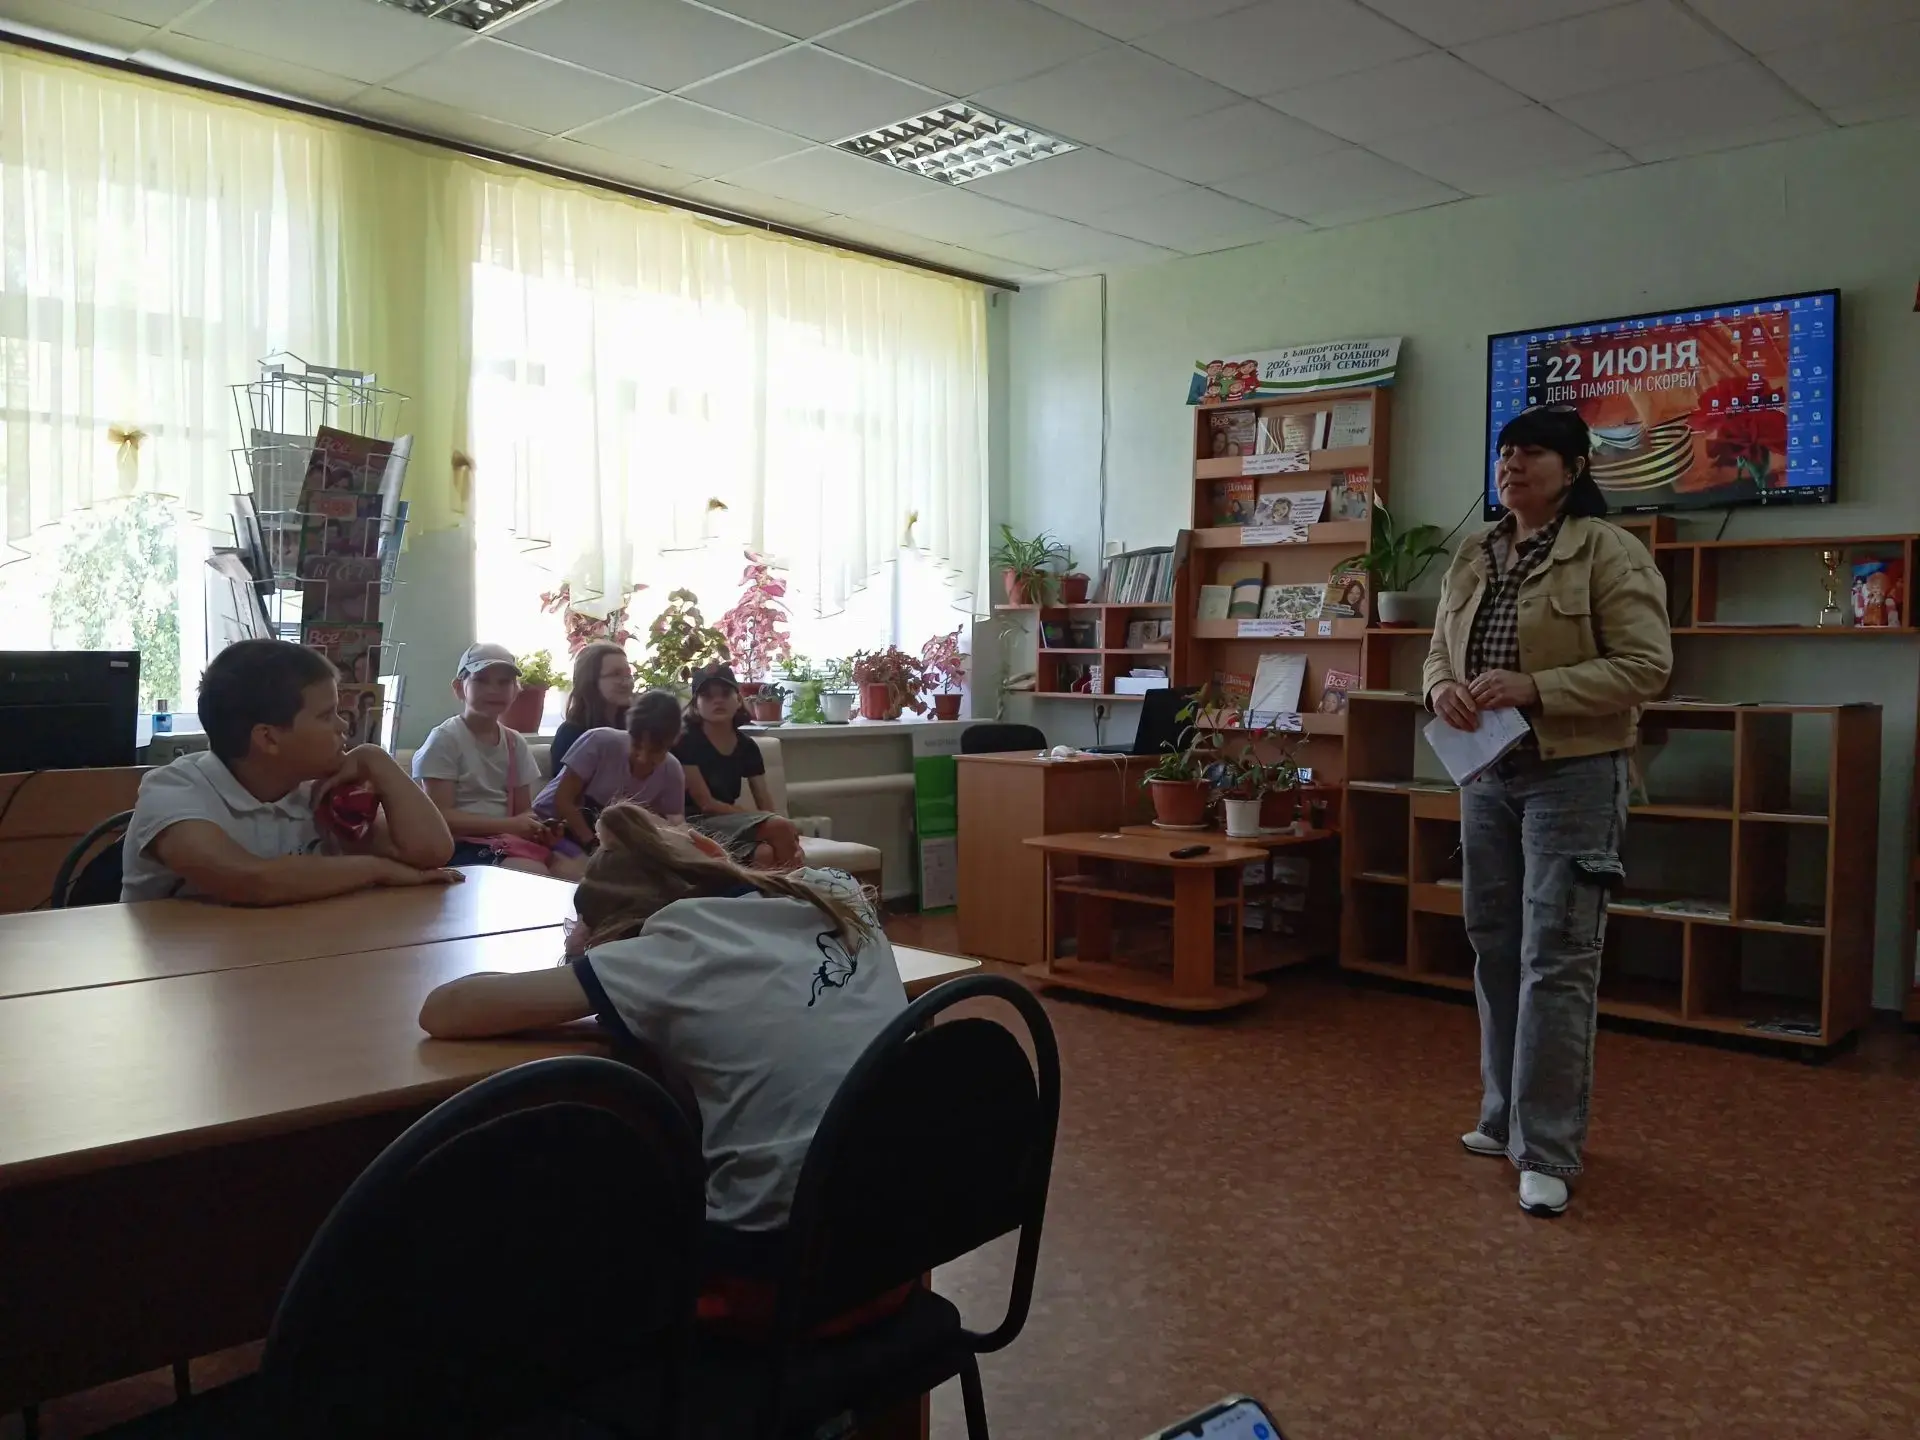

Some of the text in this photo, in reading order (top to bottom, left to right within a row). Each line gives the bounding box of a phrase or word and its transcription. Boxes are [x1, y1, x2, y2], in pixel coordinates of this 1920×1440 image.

[1267, 360, 1290, 370] 2026
[1307, 353, 1326, 363] ГОД
[1333, 348, 1390, 361] БОЛЬШОЙ
[1292, 342, 1369, 357] БАШКОРТОСТАНЕ
[1266, 359, 1380, 379] И ДРУЖНОЙ СЕМЬИ!
[1546, 355, 1581, 384] 22
[1592, 339, 1697, 377] ИЮНЯ
[1546, 371, 1697, 404] ДЕНЬ ПАМЯТИ И СКОРБИ
